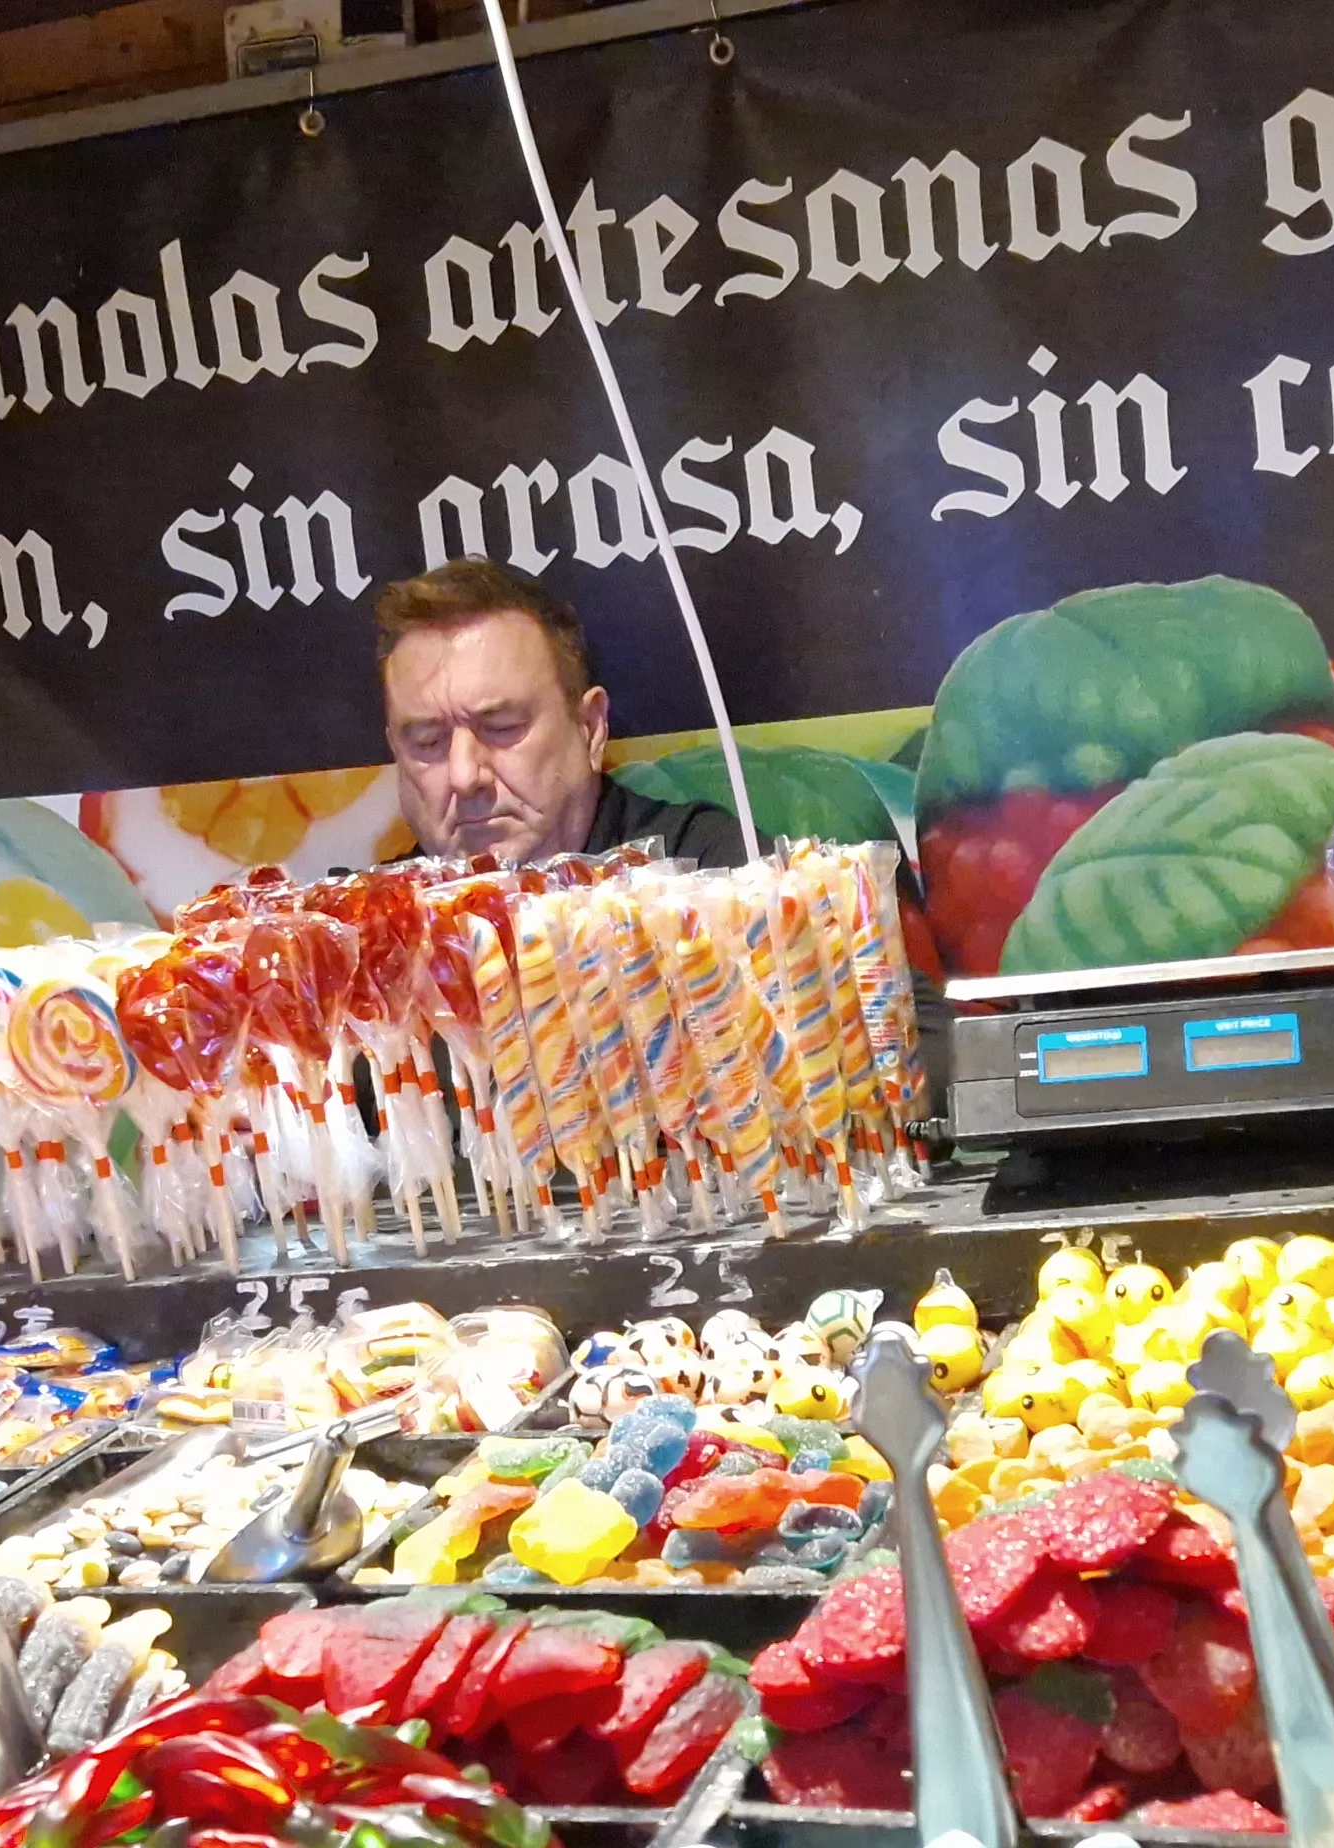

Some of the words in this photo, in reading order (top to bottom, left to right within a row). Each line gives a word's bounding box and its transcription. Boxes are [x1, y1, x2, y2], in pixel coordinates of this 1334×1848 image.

[424, 109, 1198, 354] artesanas
[160, 461, 373, 622] sin
[930, 344, 1189, 522] sin
